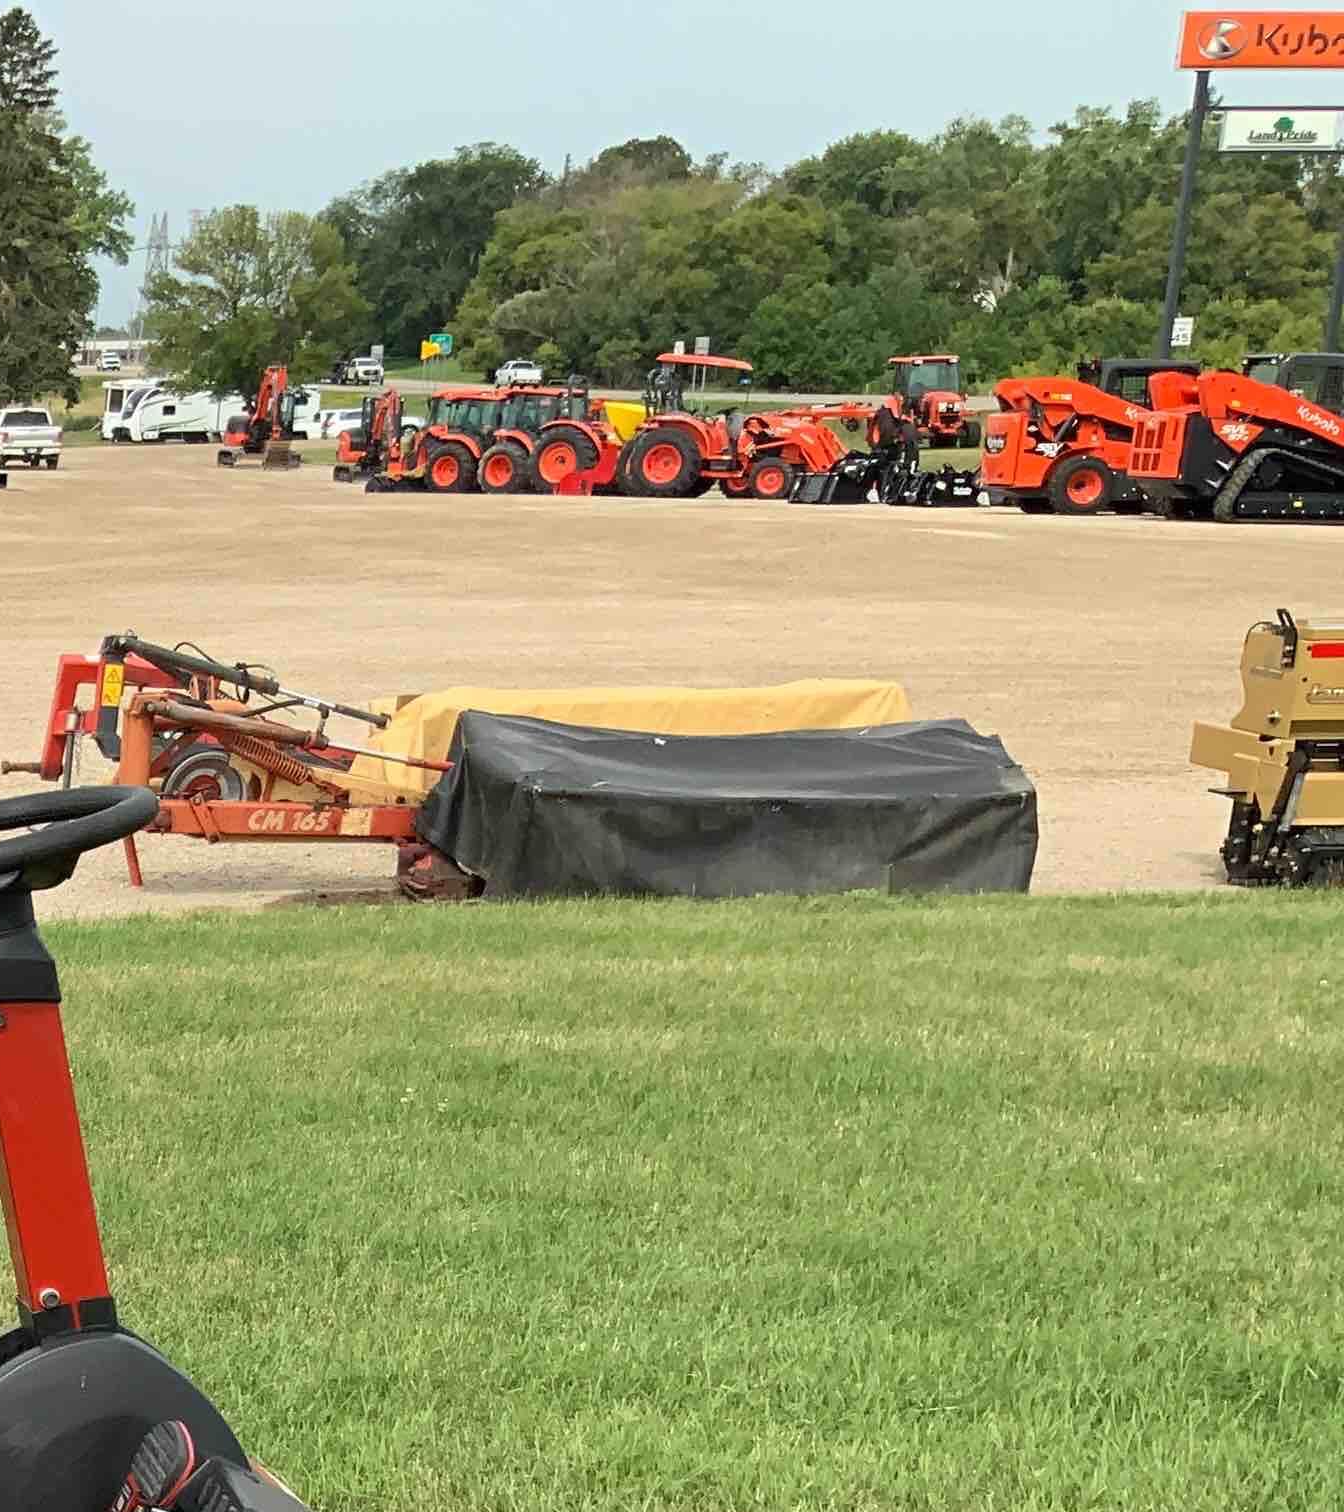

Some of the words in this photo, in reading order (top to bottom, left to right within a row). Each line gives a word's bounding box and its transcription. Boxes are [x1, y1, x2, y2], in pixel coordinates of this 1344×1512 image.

[1248, 129, 1280, 141] Land
[1285, 130, 1318, 142] Pride
[1296, 405, 1341, 436] Kubota
[248, 808, 285, 831] CM
[292, 811, 332, 831] 165
